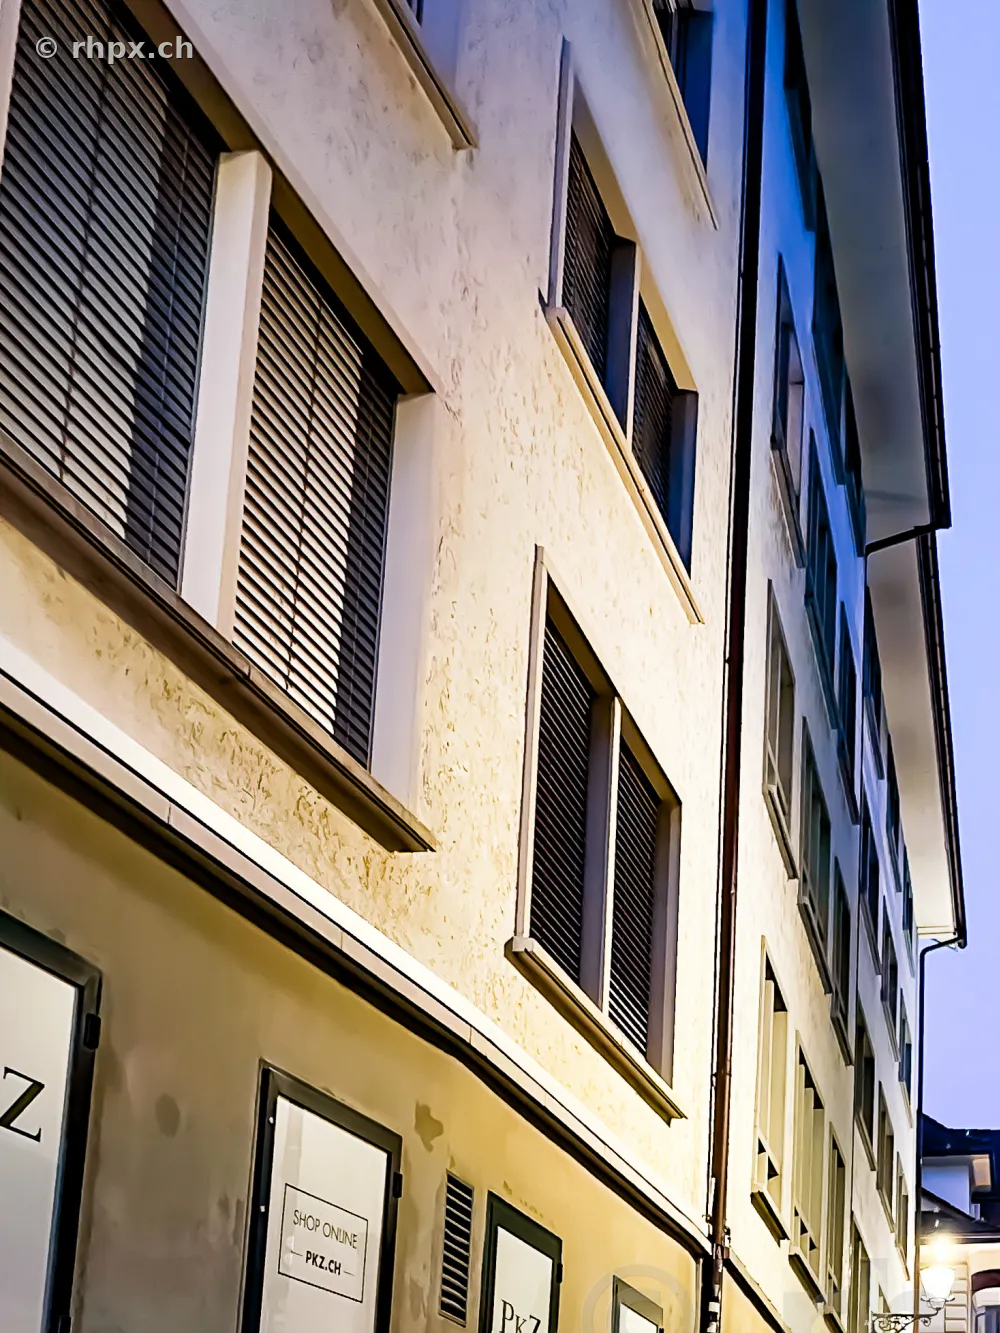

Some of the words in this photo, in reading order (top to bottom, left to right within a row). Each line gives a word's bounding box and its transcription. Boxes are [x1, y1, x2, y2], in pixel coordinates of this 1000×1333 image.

[293, 1209, 321, 1231] SHOP
[322, 1222, 358, 1249] ONLINE
[305, 1250, 342, 1275] PKZ.CH
